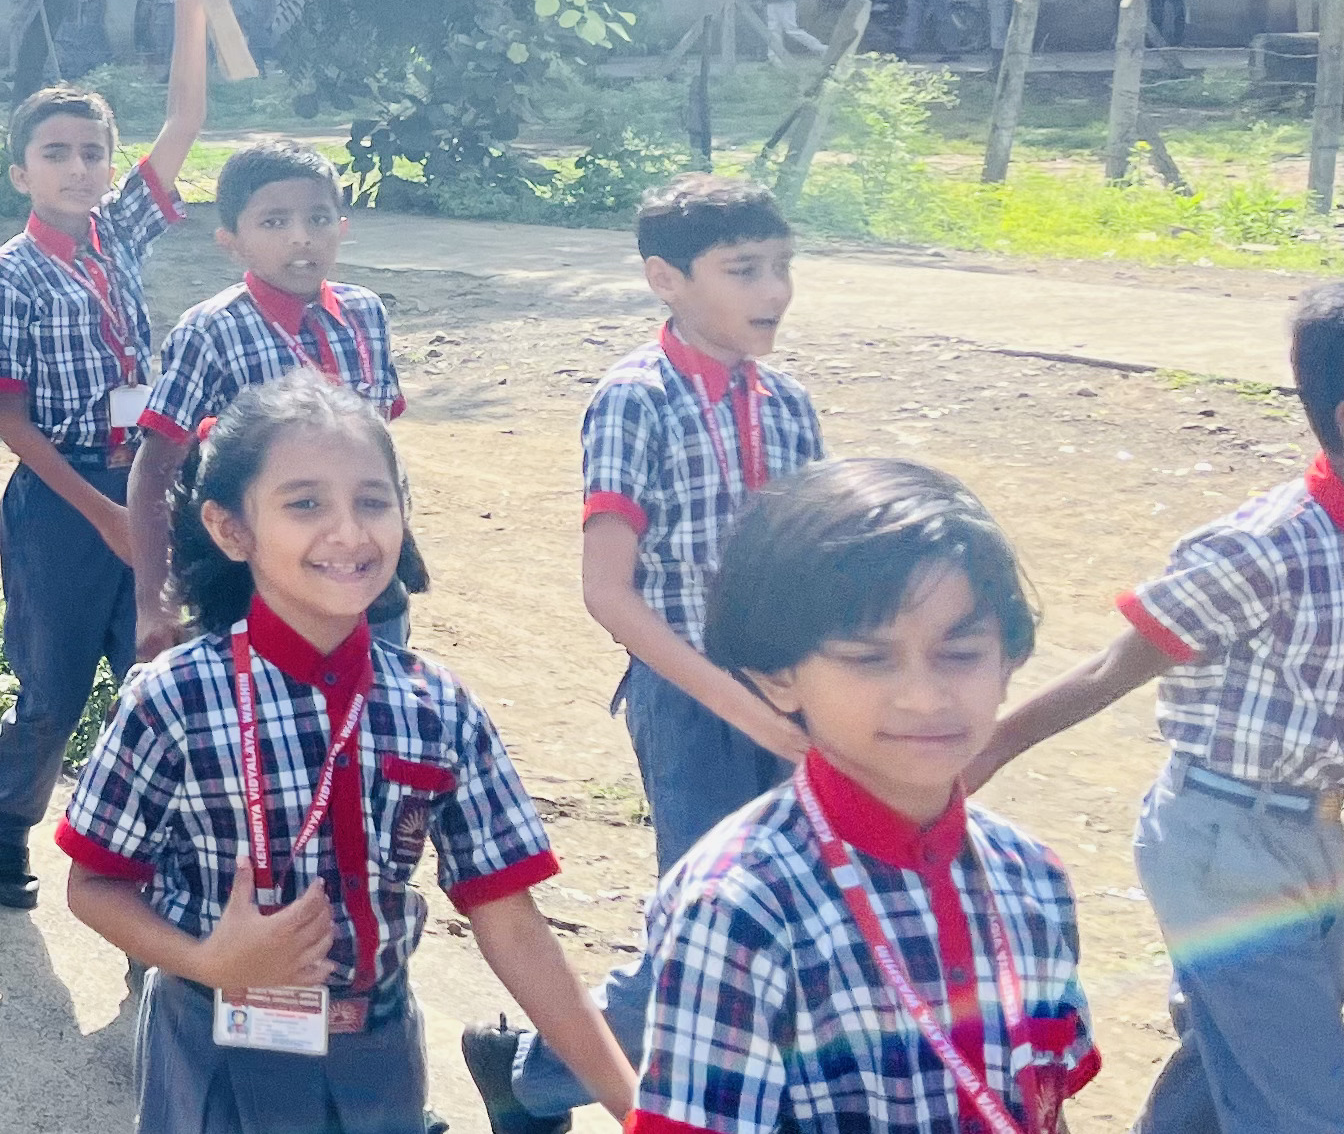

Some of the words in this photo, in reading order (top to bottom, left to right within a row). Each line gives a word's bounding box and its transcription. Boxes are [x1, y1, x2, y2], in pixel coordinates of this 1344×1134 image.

[237, 672, 253, 724] WASHIM
[243, 726, 261, 801] VIDYALAYA,
[251, 804, 268, 869] KENDRIYA
